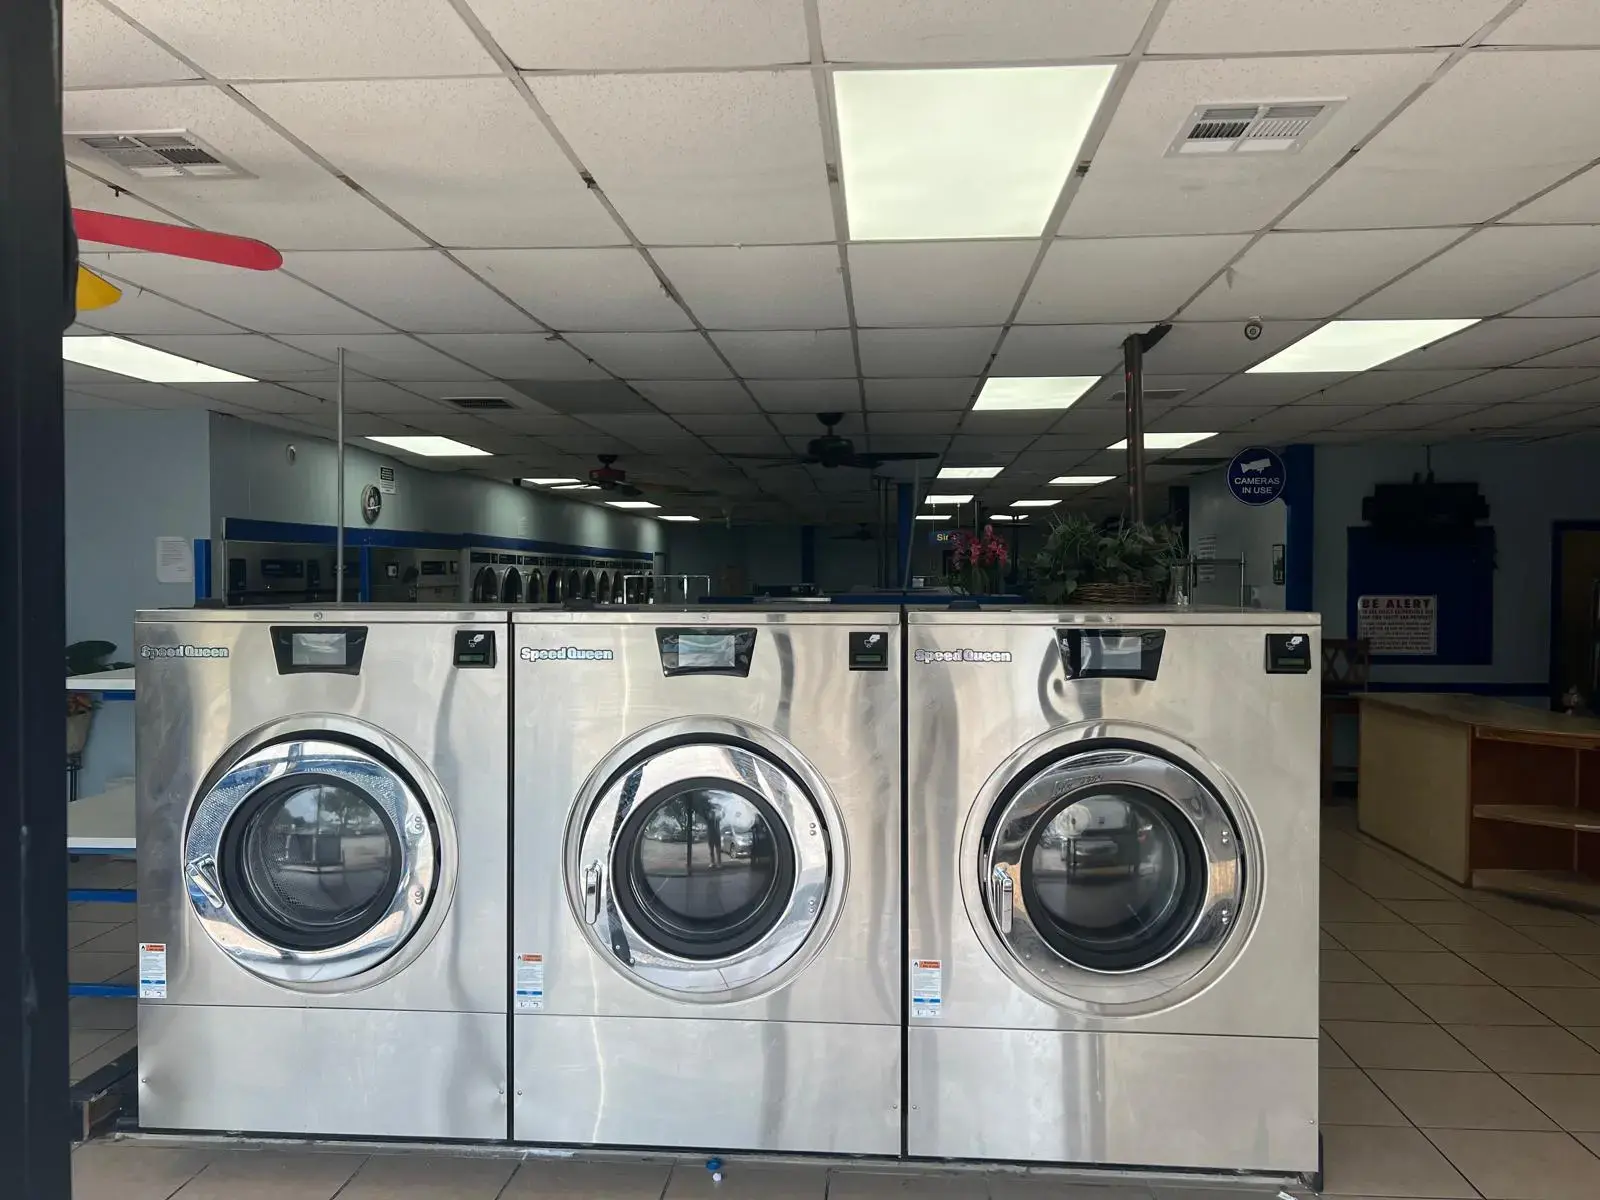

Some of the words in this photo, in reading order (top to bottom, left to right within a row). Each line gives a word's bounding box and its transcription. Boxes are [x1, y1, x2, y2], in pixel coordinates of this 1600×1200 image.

[1234, 477, 1281, 485] CAMERAS
[1242, 486, 1252, 494] IN
[1253, 486, 1272, 494] USE
[1362, 598, 1380, 608] BE
[1385, 598, 1430, 608] ALERT
[140, 645, 185, 660] Speed
[184, 645, 229, 657] Queen
[520, 647, 567, 662] Speed
[567, 647, 613, 660] Queen
[914, 649, 963, 664] Speed
[963, 649, 1012, 662] Queen
